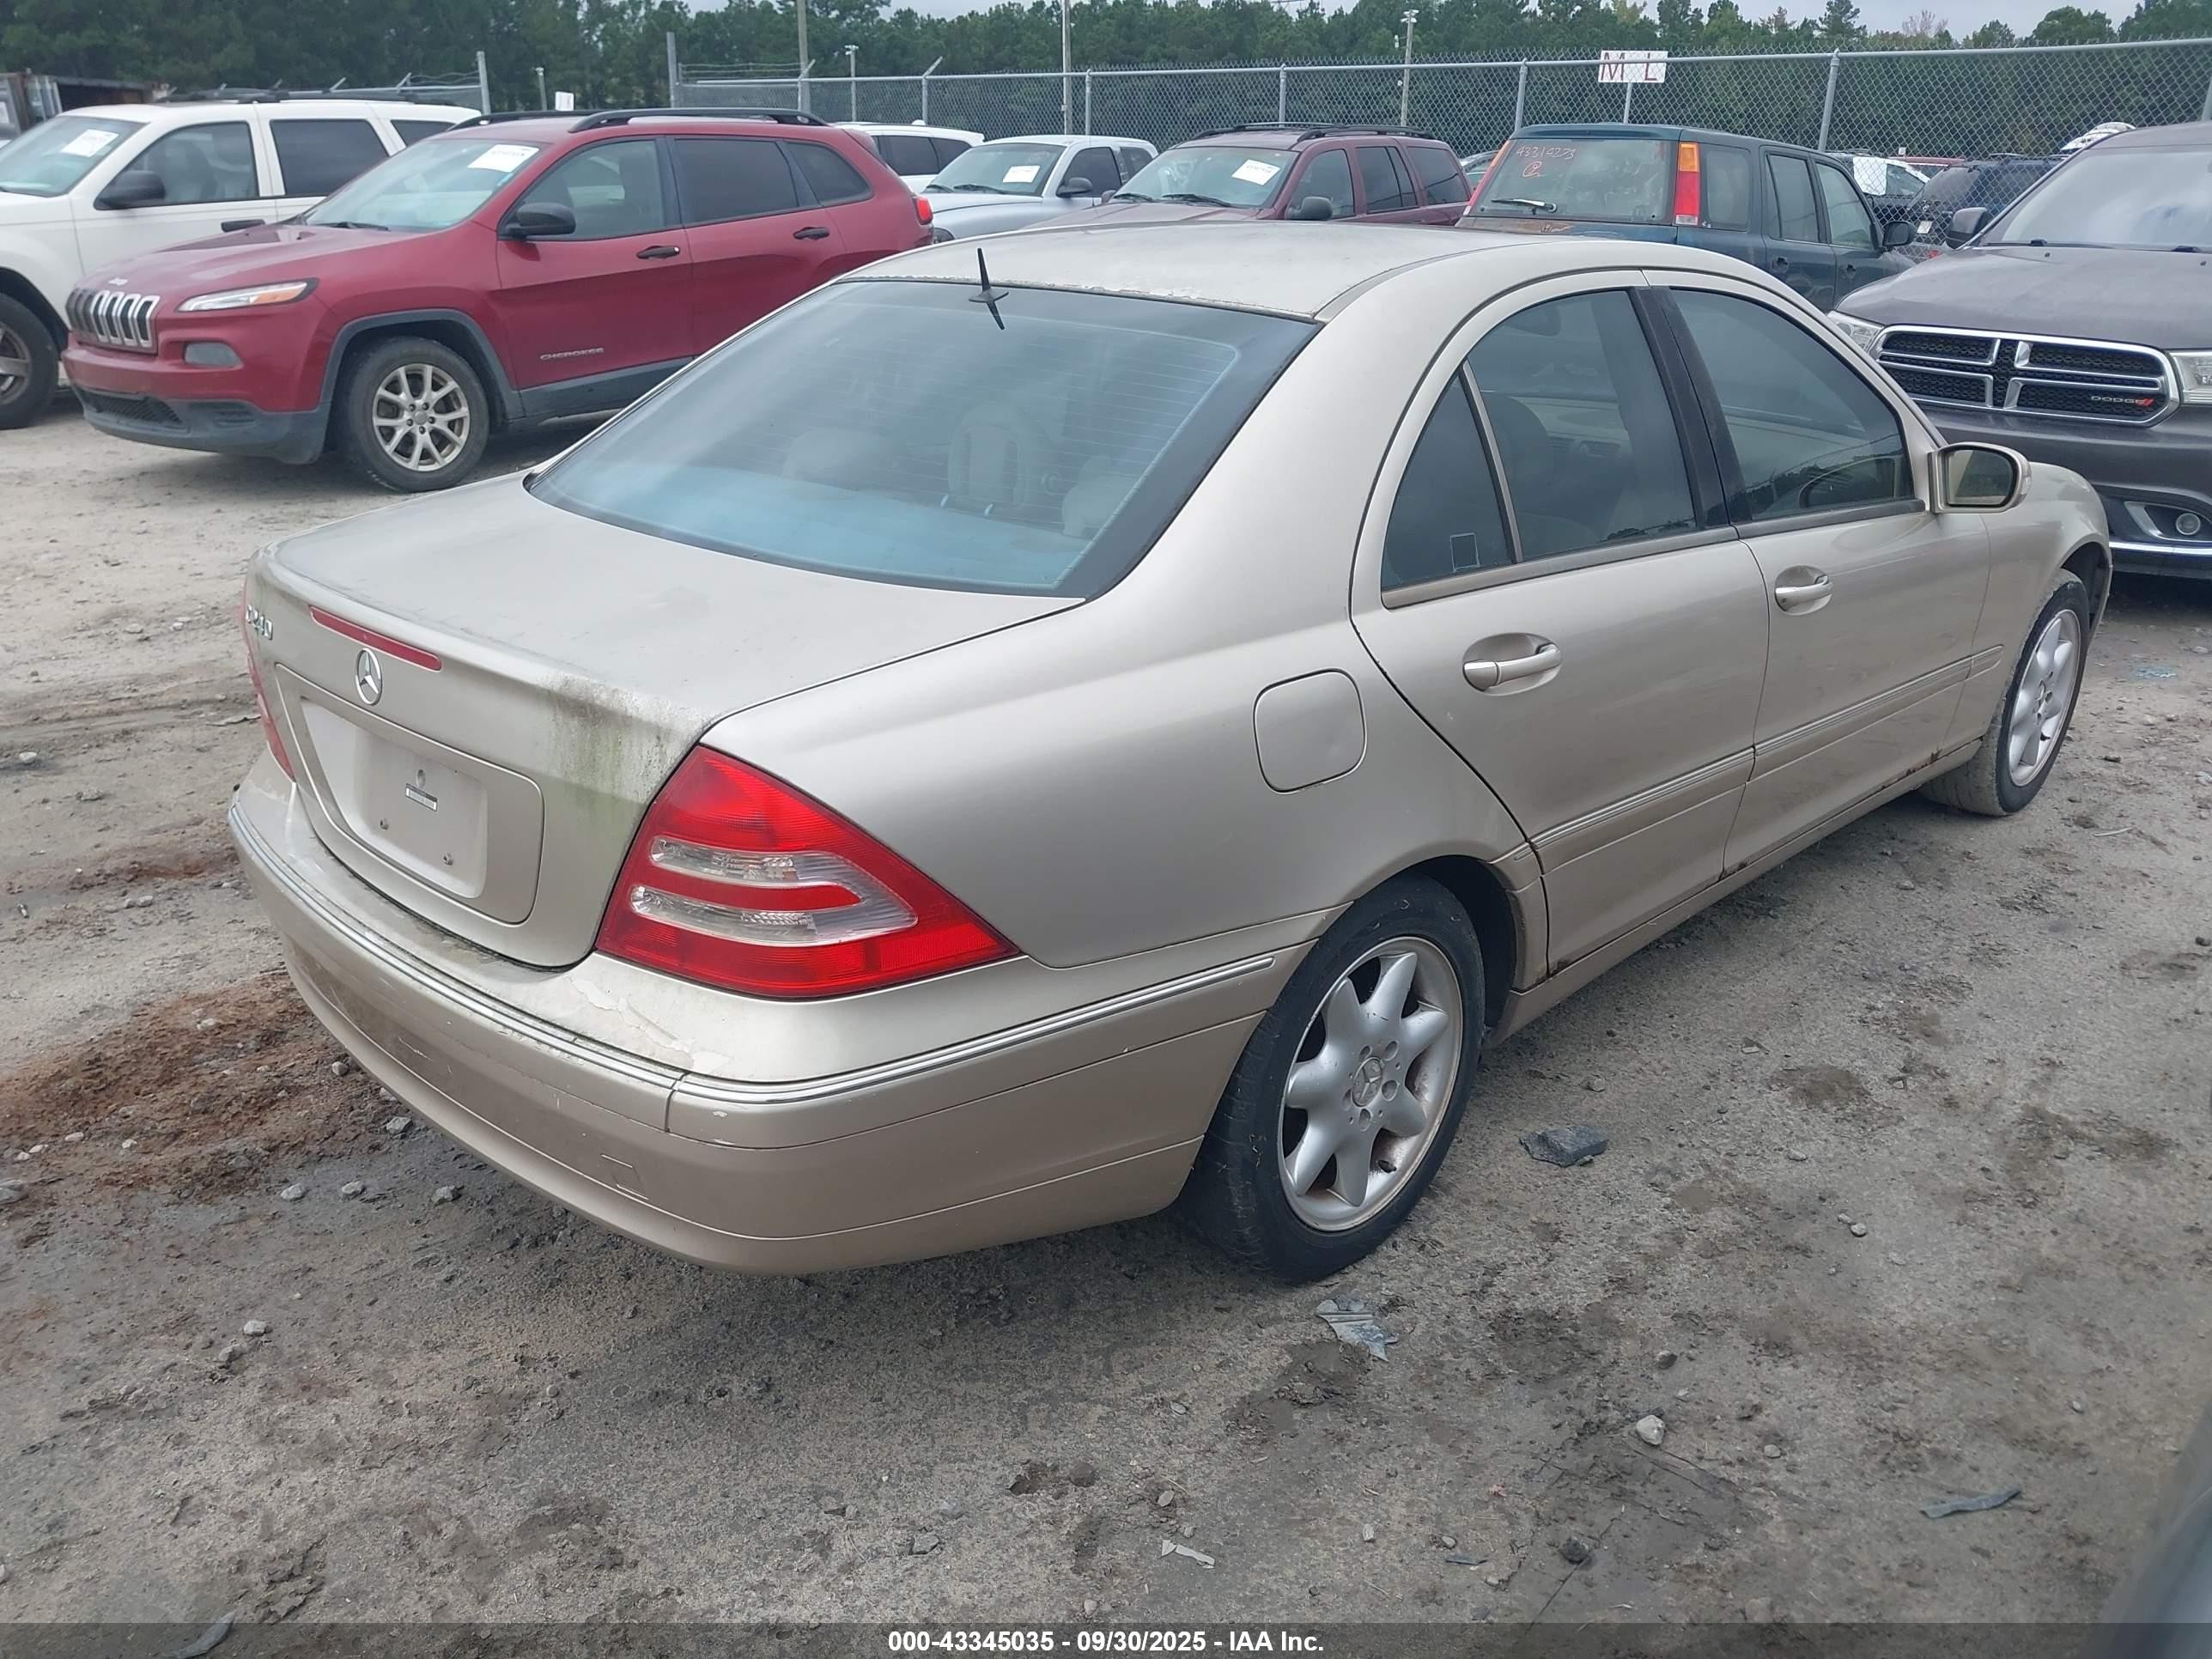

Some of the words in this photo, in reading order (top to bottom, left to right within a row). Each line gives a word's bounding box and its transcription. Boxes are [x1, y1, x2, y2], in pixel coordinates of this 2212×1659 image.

[1600, 52, 1626, 81] M
[540, 347, 604, 360] CHEROKEE
[2090, 396, 2144, 405] DODGE
